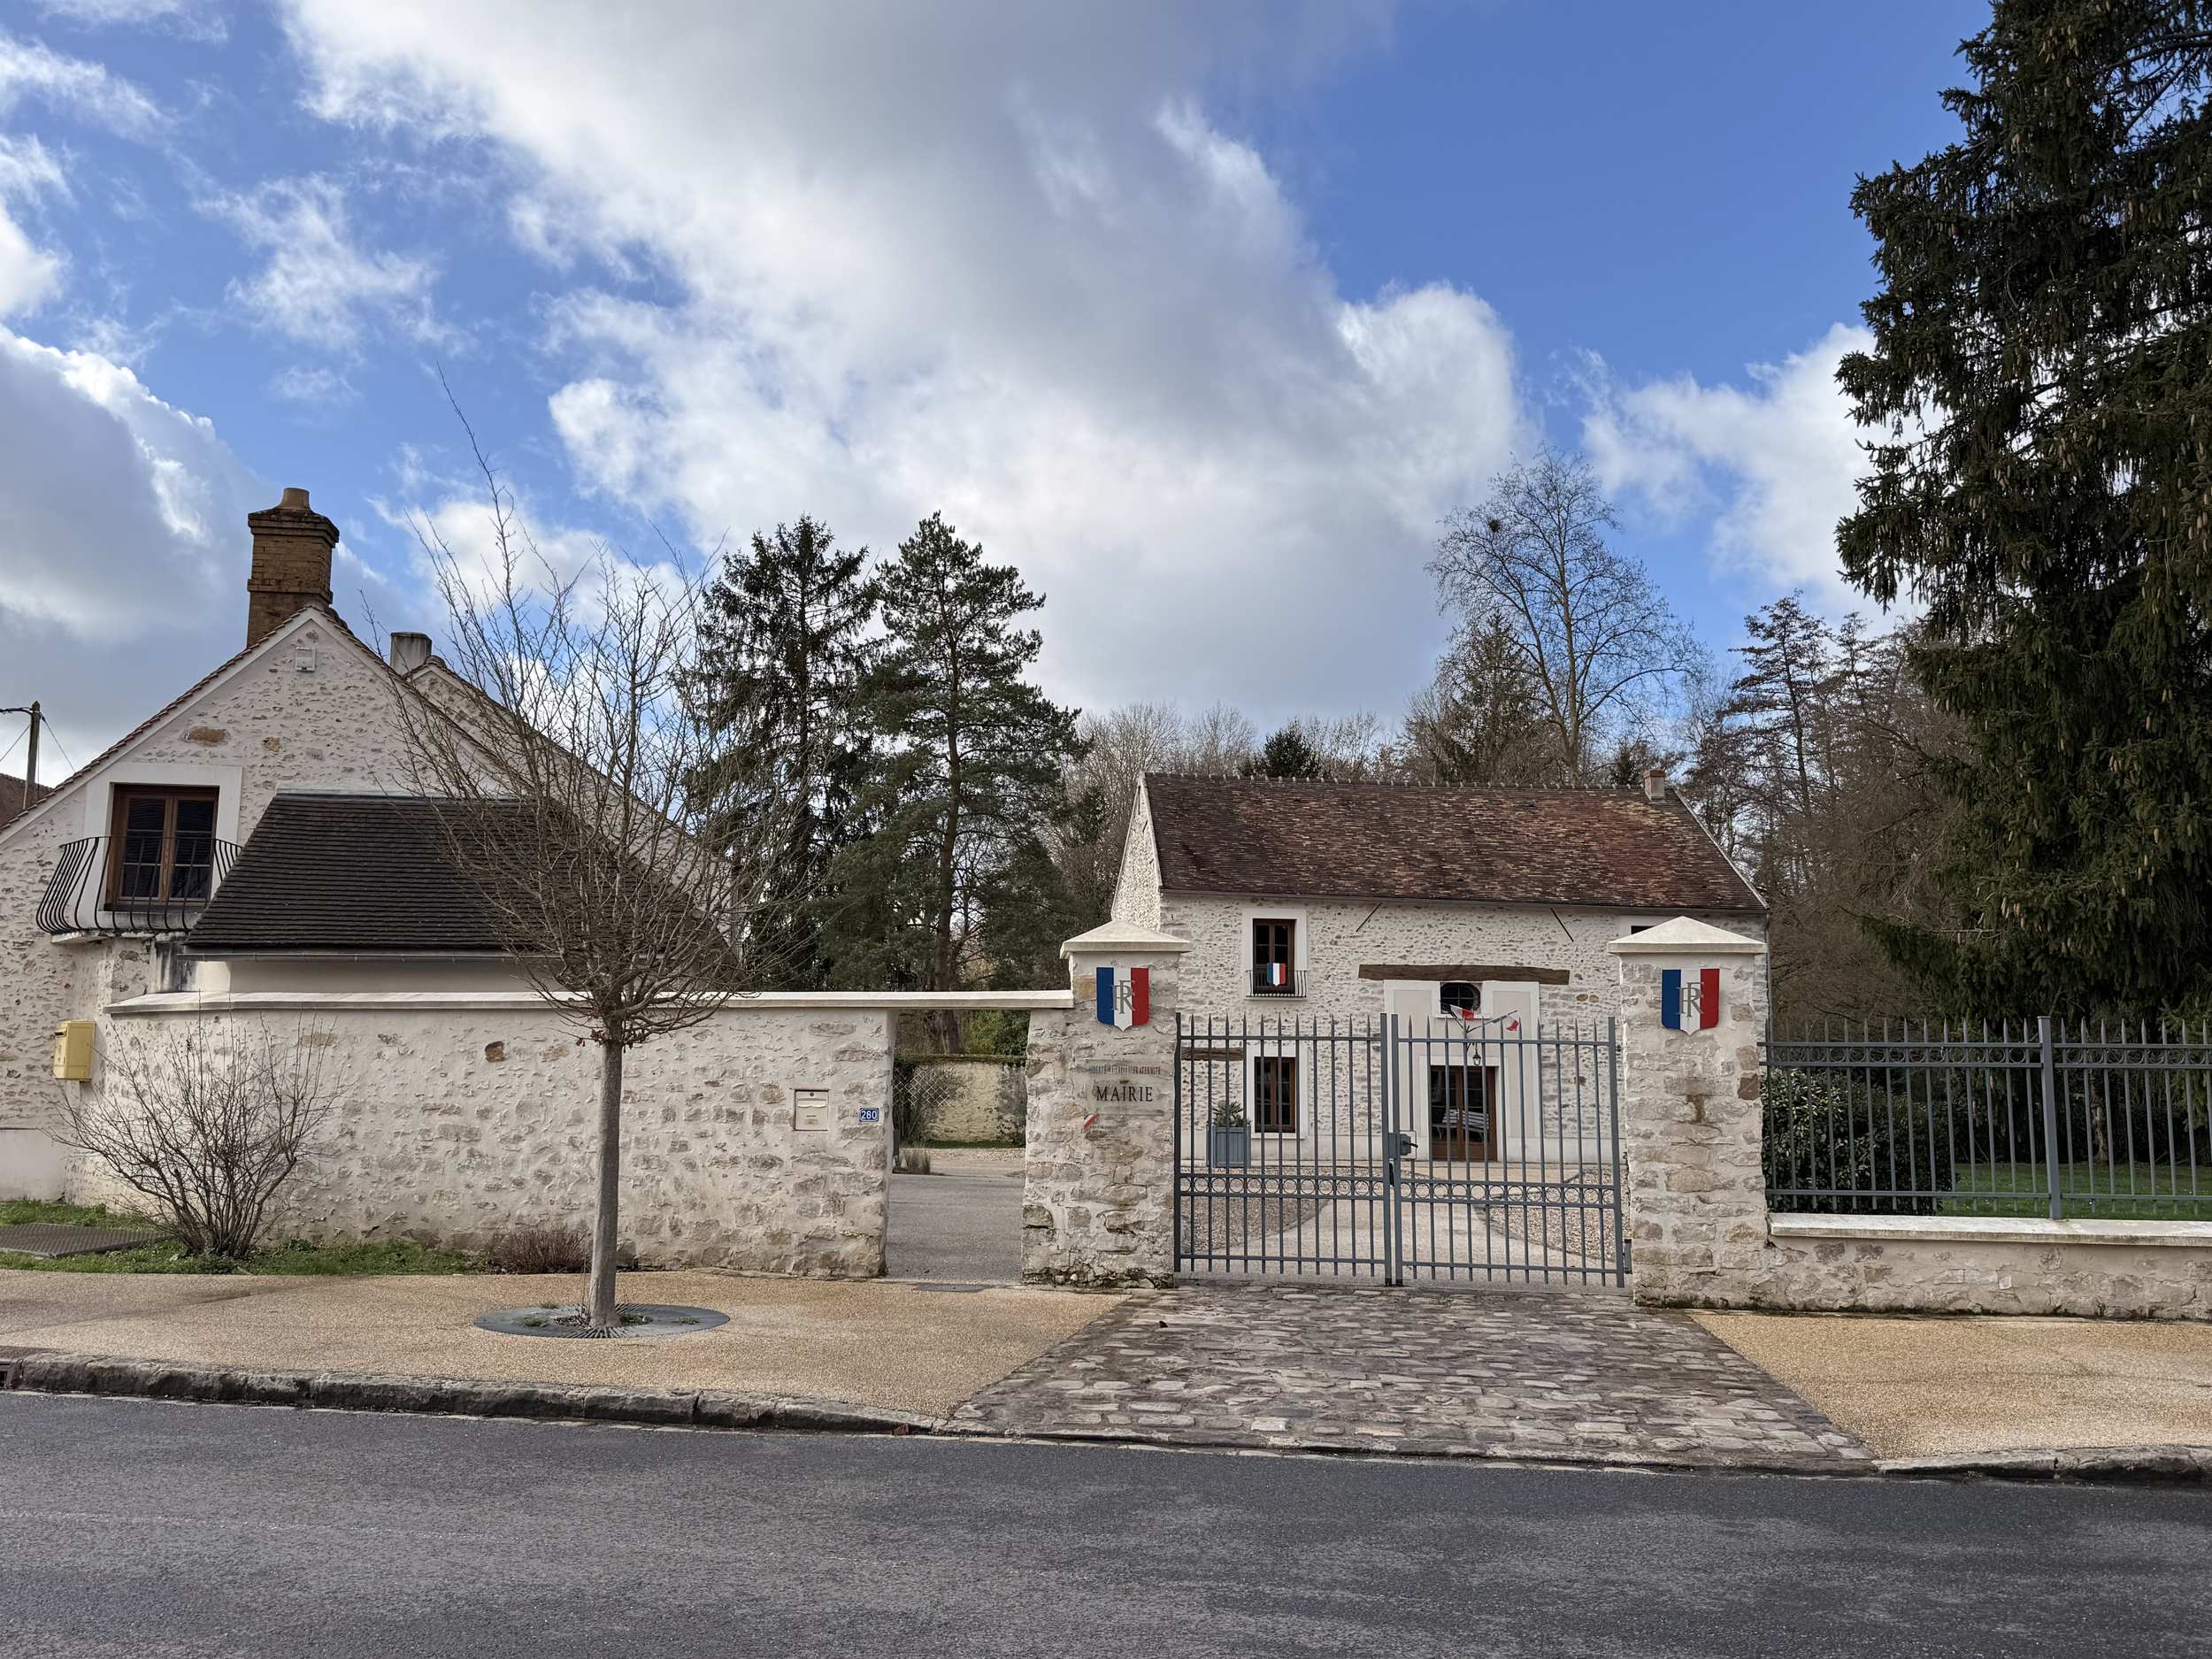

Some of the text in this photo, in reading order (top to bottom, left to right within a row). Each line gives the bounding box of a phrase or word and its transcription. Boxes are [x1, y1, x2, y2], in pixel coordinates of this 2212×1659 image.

[1133, 1065, 1161, 1075] FRATERNITÉ
[1096, 1086, 1153, 1102] MAIRIE
[861, 1110, 877, 1119] 280
